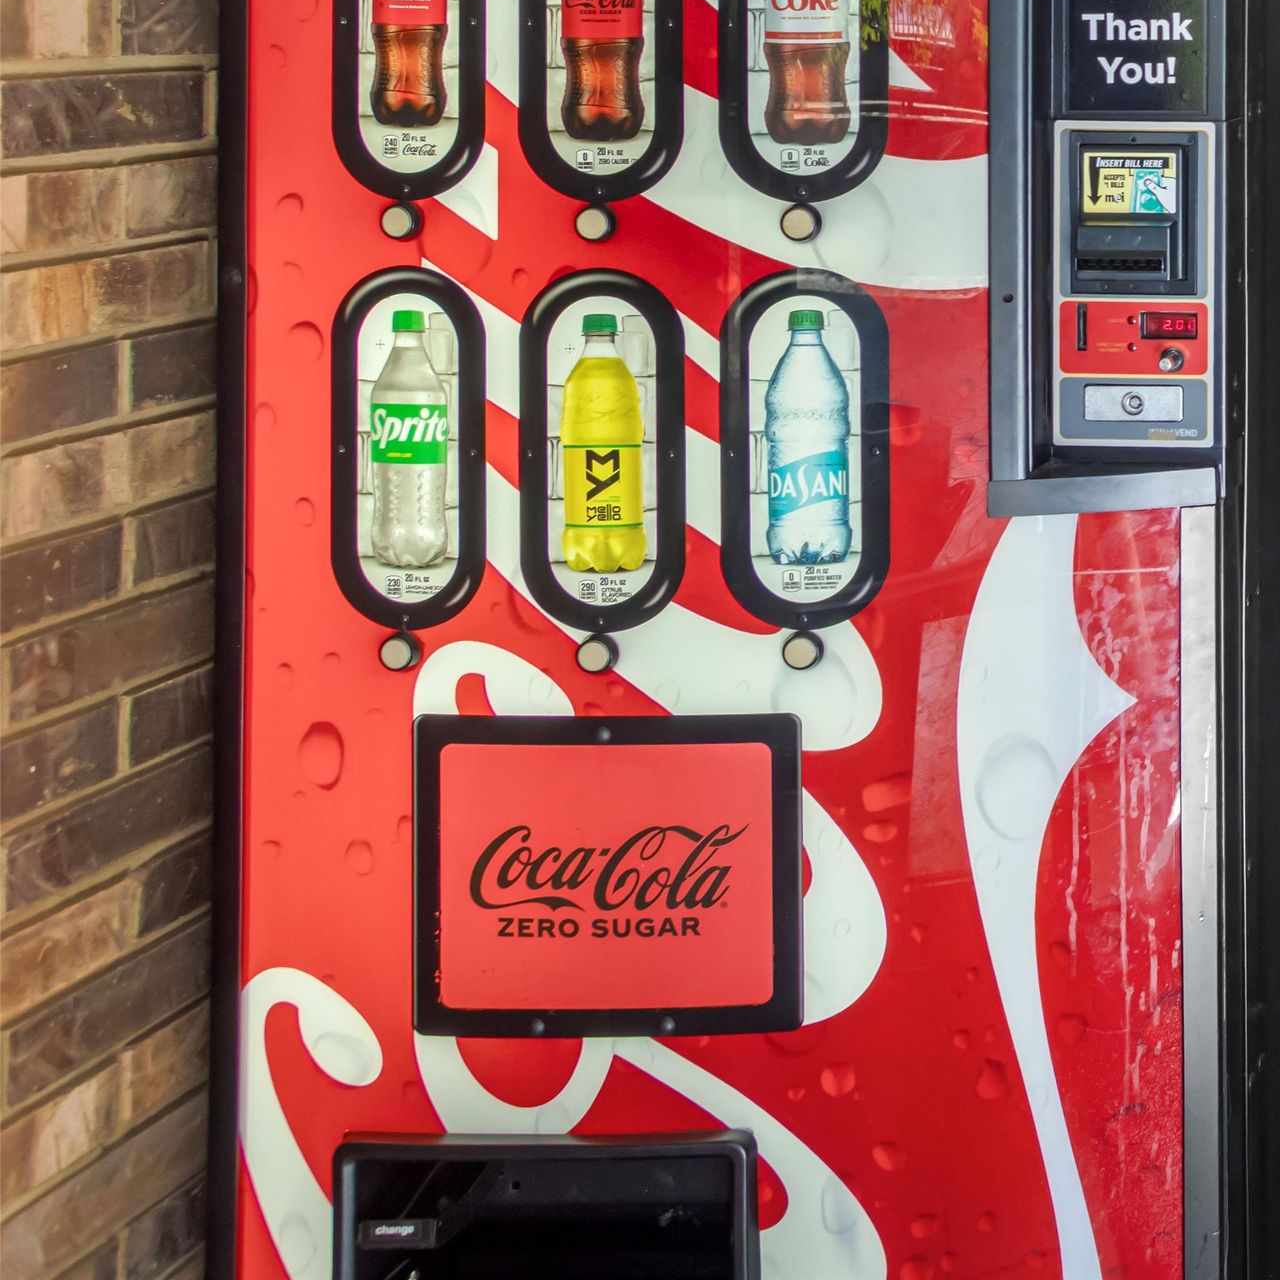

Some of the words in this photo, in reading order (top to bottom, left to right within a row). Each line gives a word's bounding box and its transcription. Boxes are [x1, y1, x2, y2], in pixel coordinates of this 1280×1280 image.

[1082, 12, 1193, 42] Thank
[1097, 56, 1177, 85] You!
[402, 133, 411, 141] 20
[384, 138, 398, 147] 240
[403, 144, 438, 156] Coca-Cola
[597, 147, 606, 156] 20
[582, 152, 588, 161] 0
[787, 152, 793, 160] 0
[804, 158, 830, 167] Coke
[1124, 160, 1142, 168] BILL
[1143, 160, 1164, 168] HERE
[371, 407, 447, 450] Sprite
[770, 464, 847, 507] DASANI
[806, 566, 815, 574] 20
[405, 574, 413, 582] 20
[600, 577, 609, 585] 20
[788, 572, 794, 581] 0
[387, 579, 401, 587] 230
[581, 583, 596, 591] 290
[469, 823, 751, 912] Coca-Cola
[497, 917, 579, 938] ZERO
[591, 917, 701, 939] SUGAR
[375, 1224, 415, 1237] change
